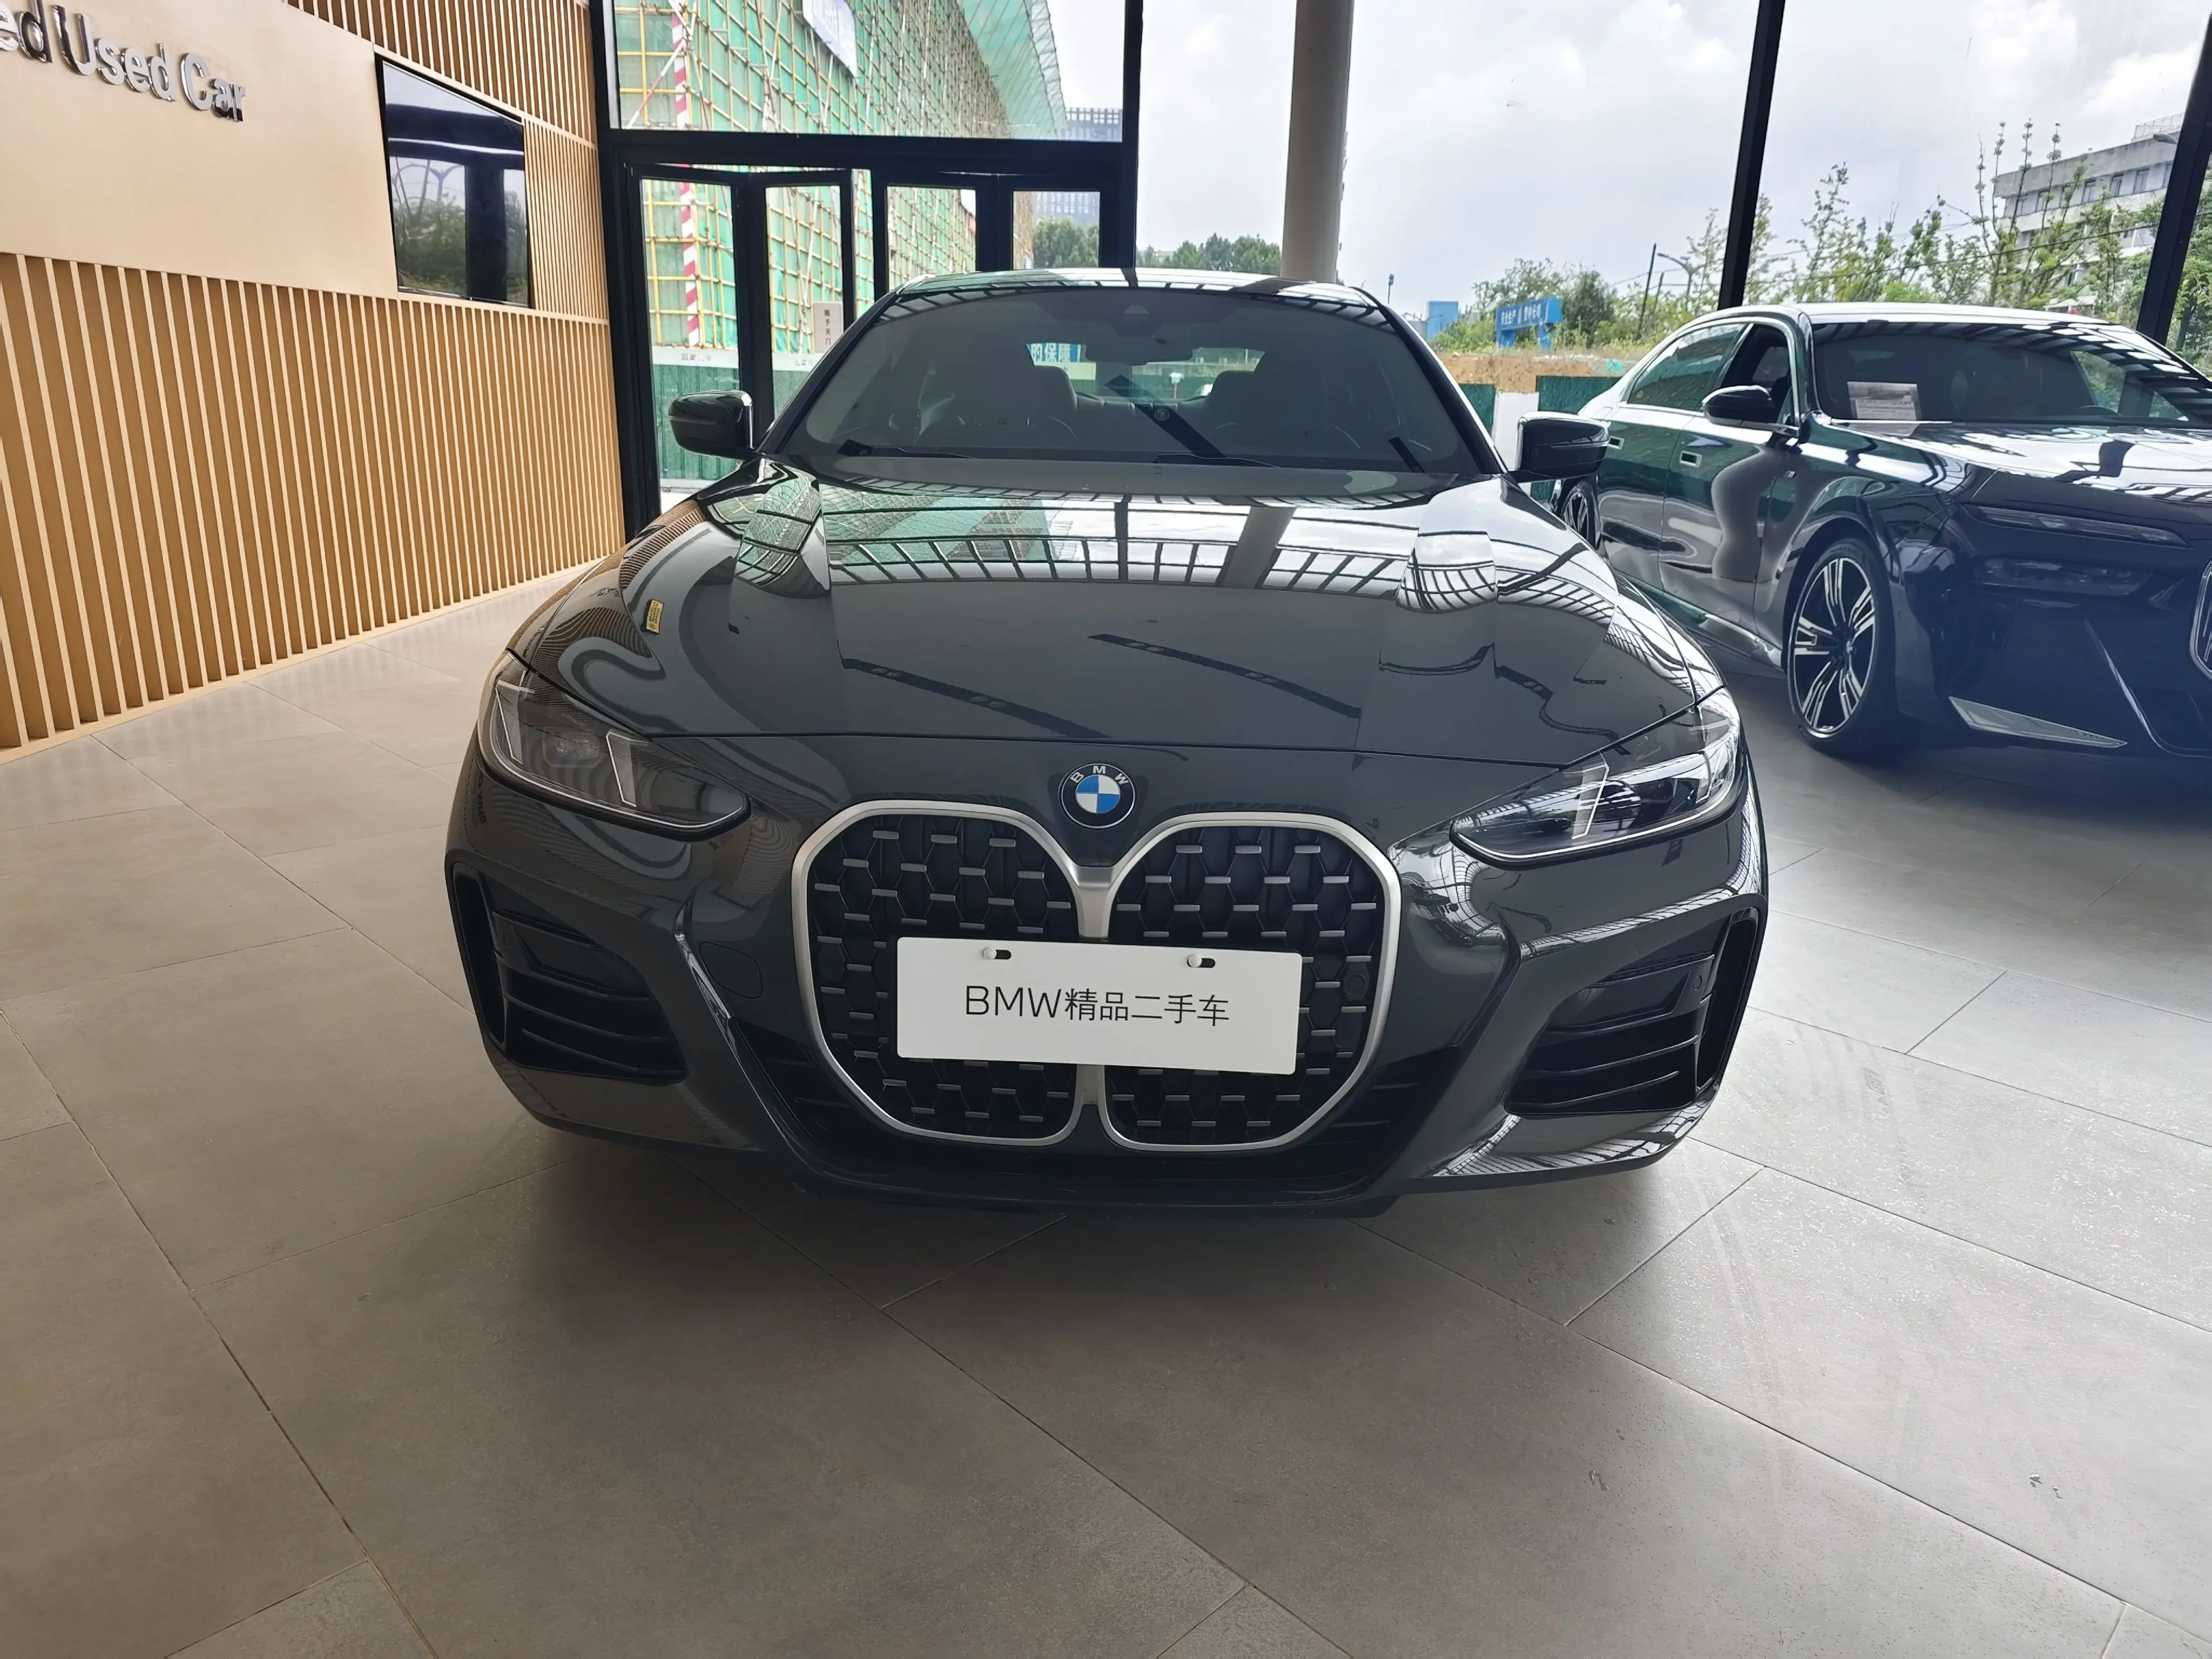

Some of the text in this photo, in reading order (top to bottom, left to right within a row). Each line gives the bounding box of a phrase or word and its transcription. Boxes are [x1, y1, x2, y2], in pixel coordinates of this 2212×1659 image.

[51, 5, 176, 102] Used
[180, 52, 246, 122] Car
[1070, 765, 1129, 785] BMW
[965, 984, 1230, 1027] BMW精品二手车
